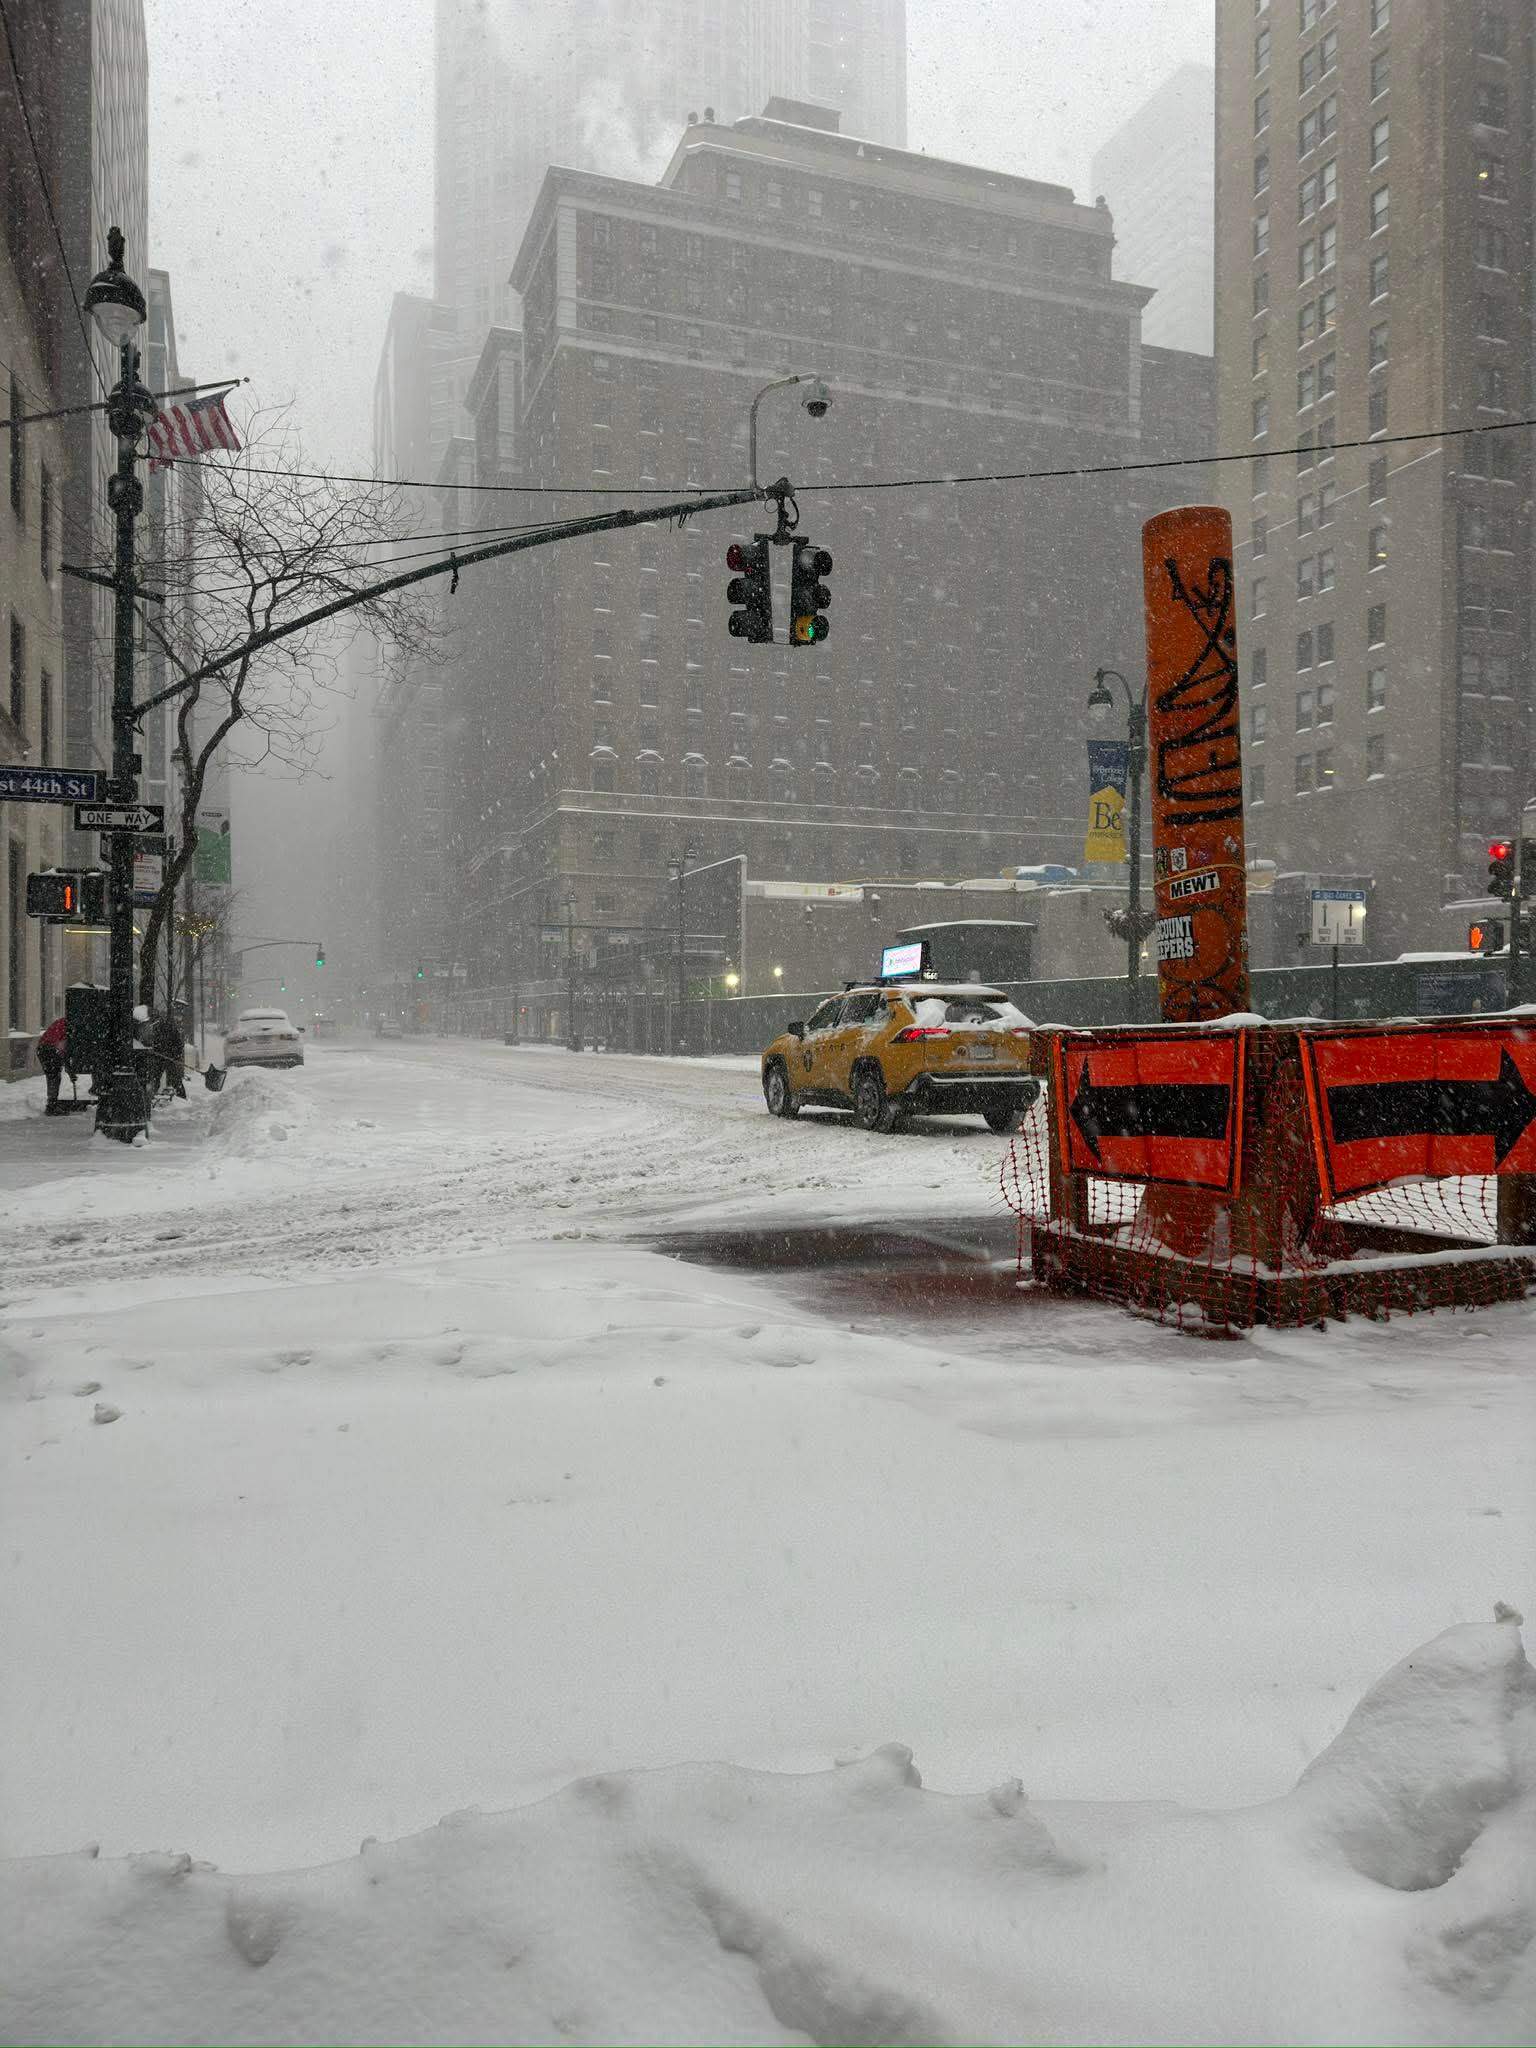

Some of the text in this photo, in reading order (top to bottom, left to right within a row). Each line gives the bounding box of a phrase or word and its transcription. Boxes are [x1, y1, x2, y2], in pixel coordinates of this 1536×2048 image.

[21, 777, 62, 794] 44th
[68, 780, 88, 796] St
[87, 812, 150, 825] ONE WAY
[1093, 802, 1121, 831] Be
[1170, 872, 1217, 898] MEWT
